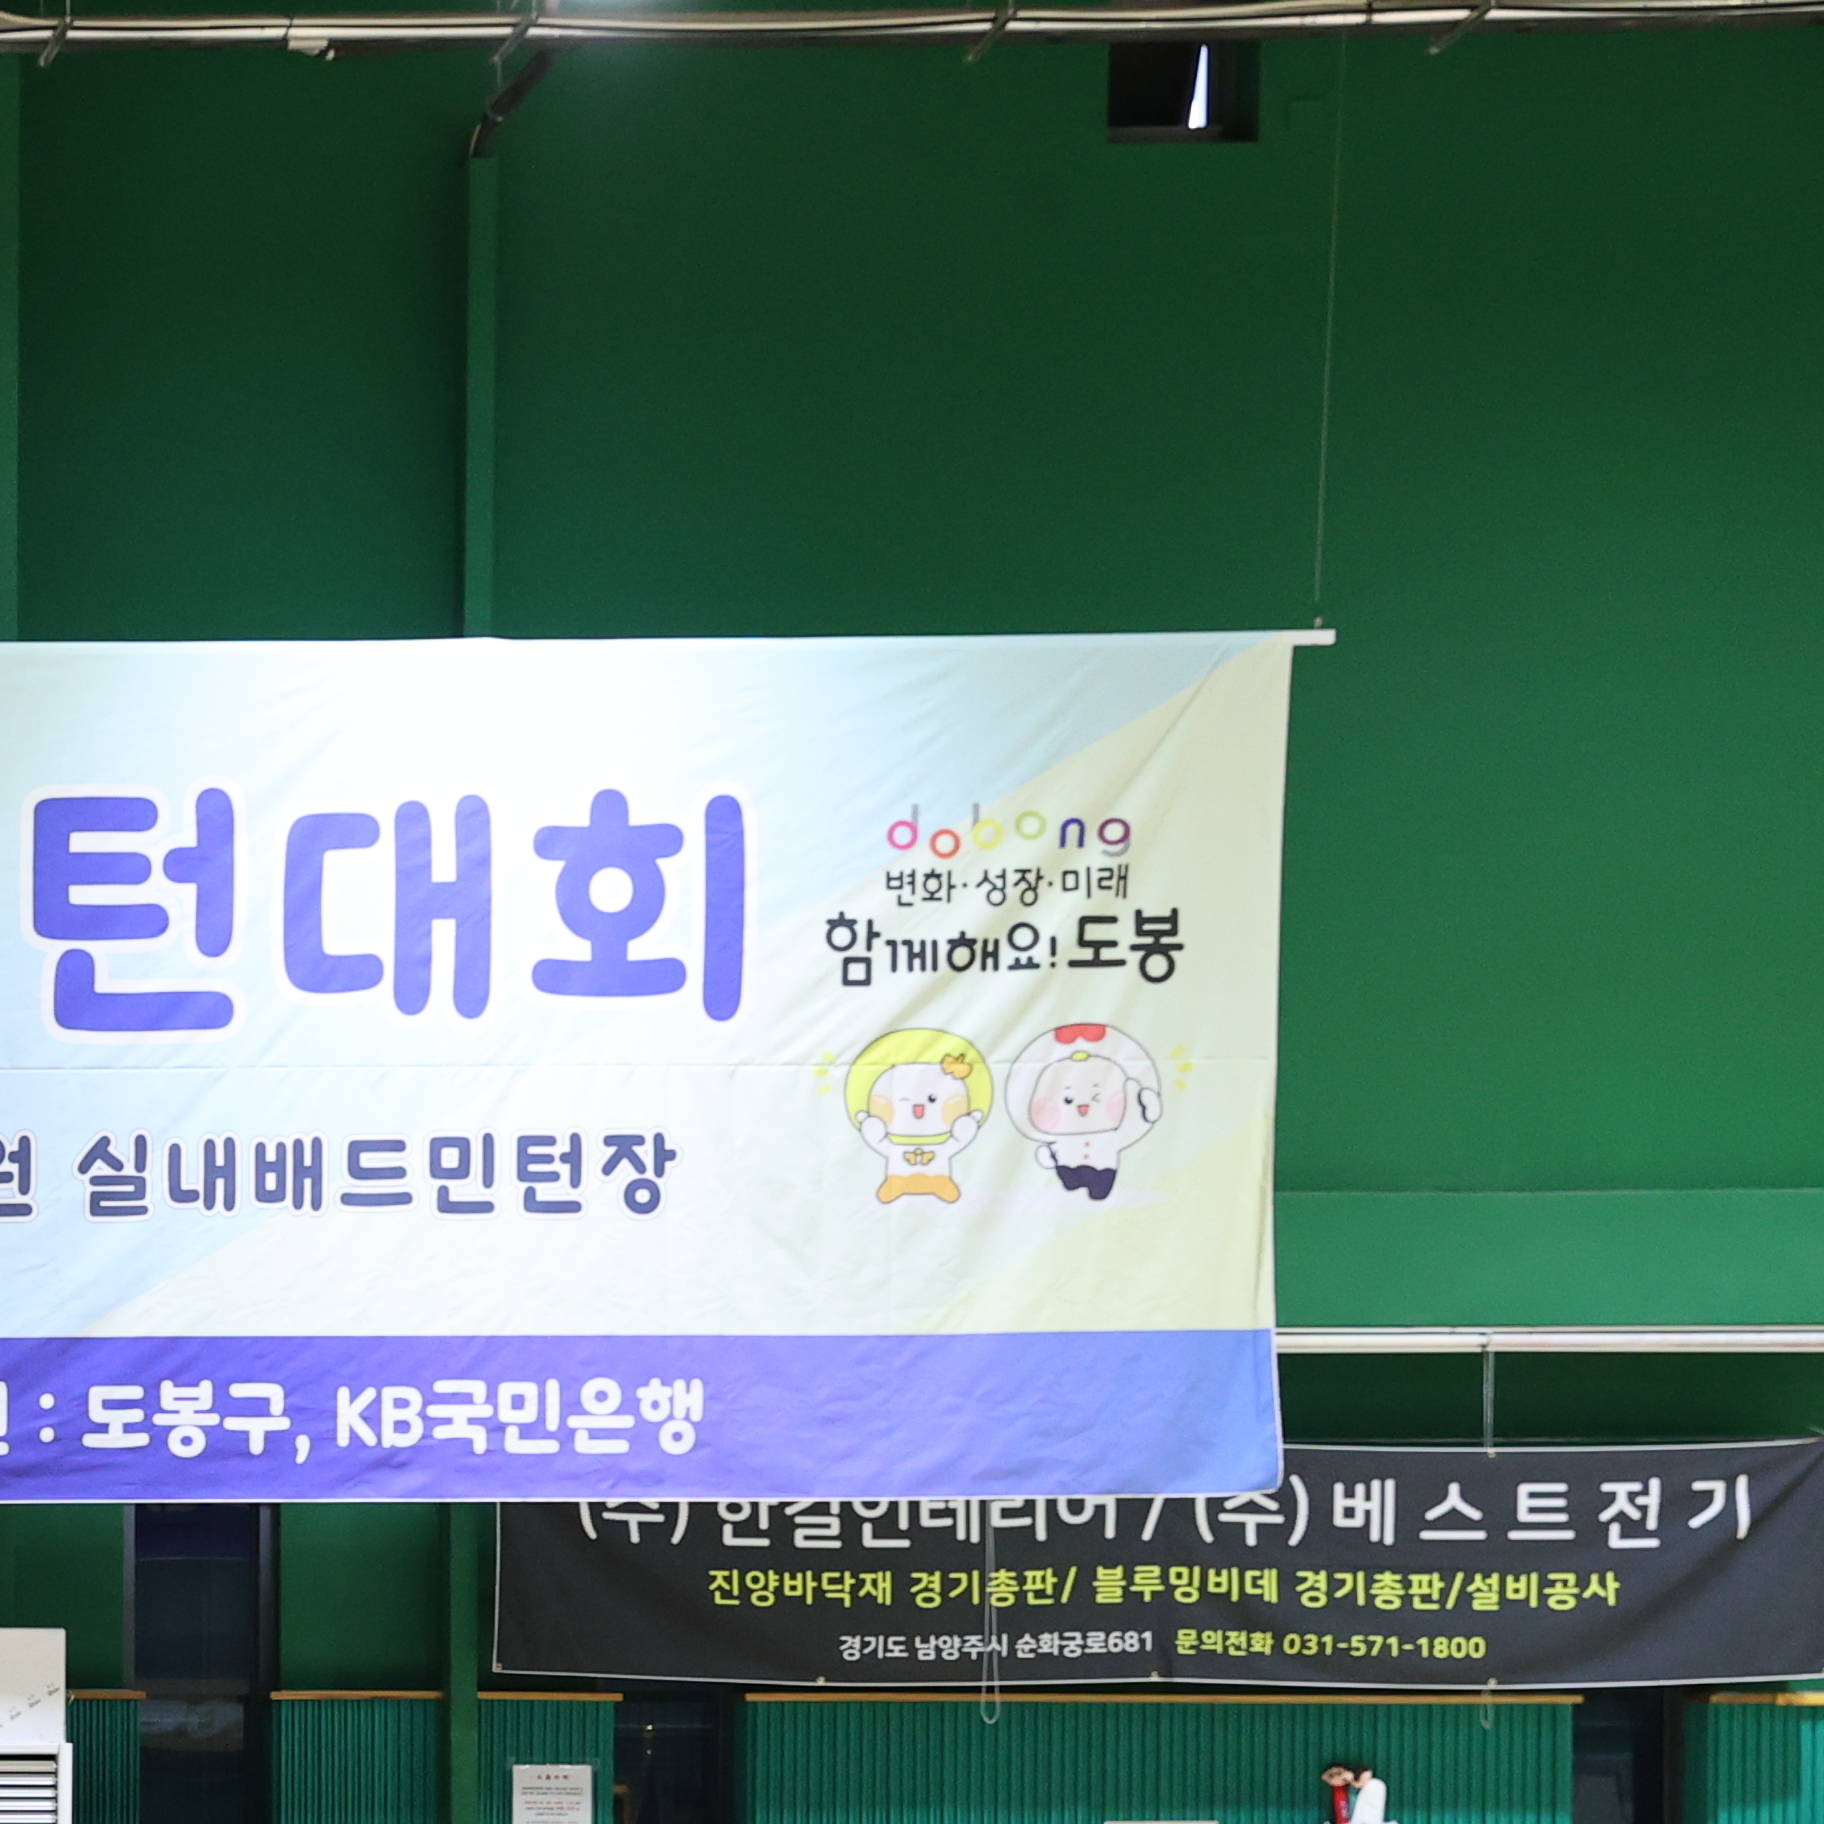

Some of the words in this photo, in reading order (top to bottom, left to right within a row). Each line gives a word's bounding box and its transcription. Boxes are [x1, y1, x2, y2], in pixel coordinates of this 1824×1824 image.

[887, 802, 1131, 859] dobong
[78, 1132, 677, 1217] 실내배드민턴장
[335, 1378, 704, 1457] KB국민은행
[708, 1568, 893, 1608] 진양바닥재
[1092, 1564, 1278, 1606] 블루밍비데
[838, 1634, 909, 1661] 경기도
[914, 1634, 1009, 1661] 남양주시
[1014, 1630, 1154, 1660] 순화궁로681
[1174, 1630, 1273, 1657] 문의전화
[1282, 1633, 1487, 1660] 031-571-1800
